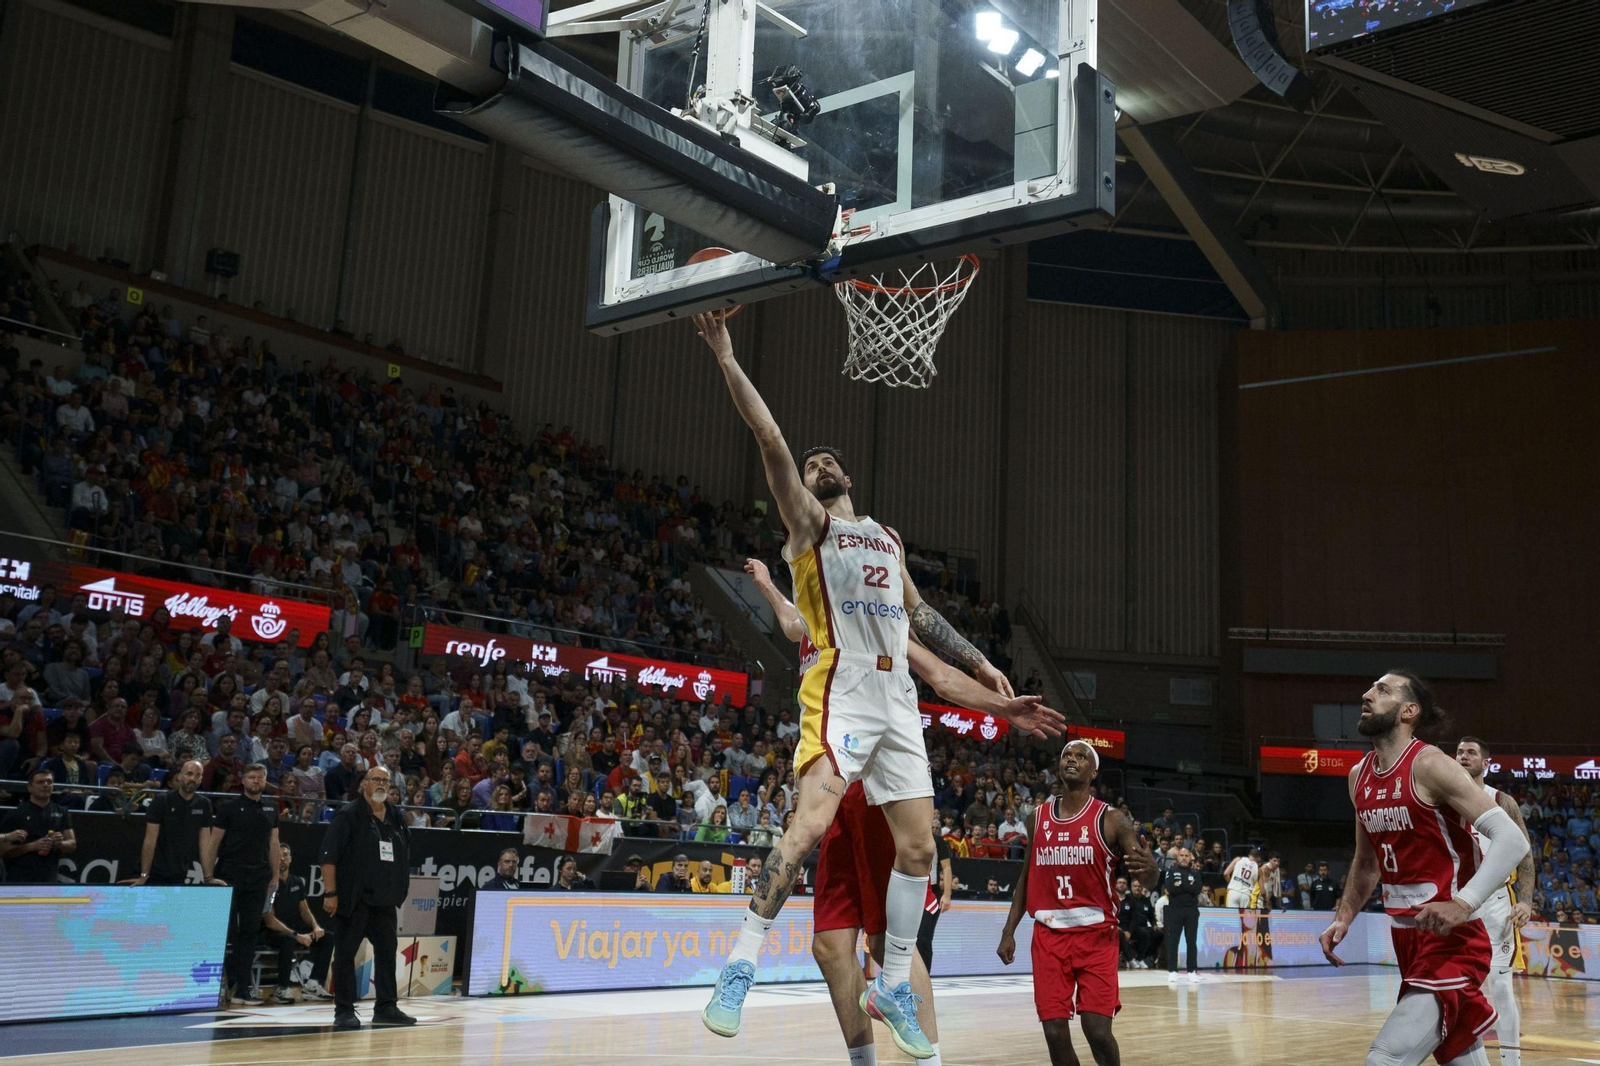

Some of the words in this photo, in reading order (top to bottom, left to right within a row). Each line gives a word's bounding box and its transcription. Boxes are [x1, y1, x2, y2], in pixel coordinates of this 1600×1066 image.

[838, 533, 898, 560] ESPAÑA
[862, 564, 890, 589] 22
[413, 630, 420, 643] P
[445, 638, 506, 667] renfe
[1241, 867, 1251, 880] 10
[1056, 876, 1073, 899] 25
[550, 920, 657, 969] Viajar
[663, 930, 700, 968] ya
[1204, 926, 1236, 950] Viajar
[1236, 932, 1249, 950] ya
[1251, 932, 1263, 946] no
[1264, 932, 1276, 946] es
[1537, 943, 1563, 958] no
[1568, 945, 1592, 959] es
